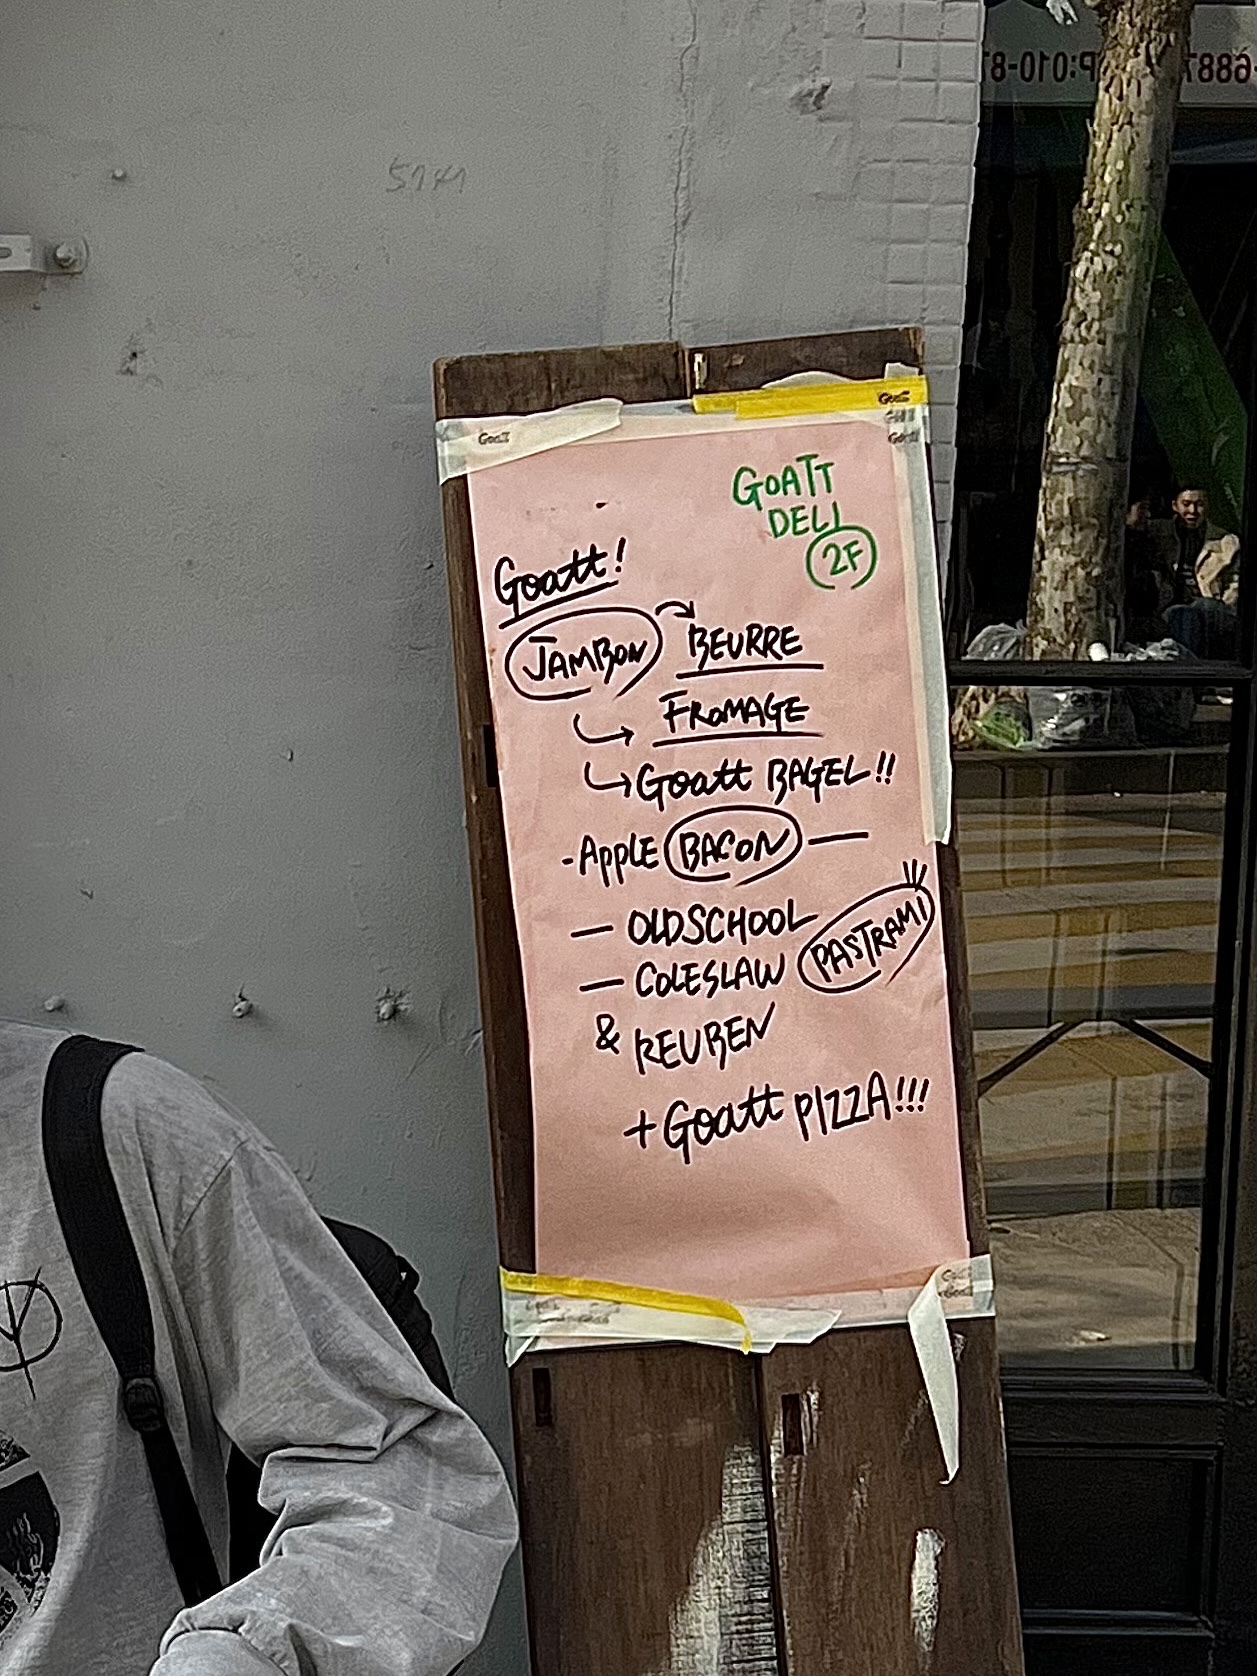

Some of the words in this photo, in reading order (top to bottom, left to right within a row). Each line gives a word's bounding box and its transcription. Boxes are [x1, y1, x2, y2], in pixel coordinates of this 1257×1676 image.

[768, 501, 843, 539] DELI
[822, 541, 863, 576] 2F
[688, 624, 805, 672] BEURRE
[636, 758, 755, 813] Goatt
[809, 896, 928, 984] PASTRAMI
[595, 1013, 621, 1055] &
[634, 1001, 776, 1076] REUBEN
